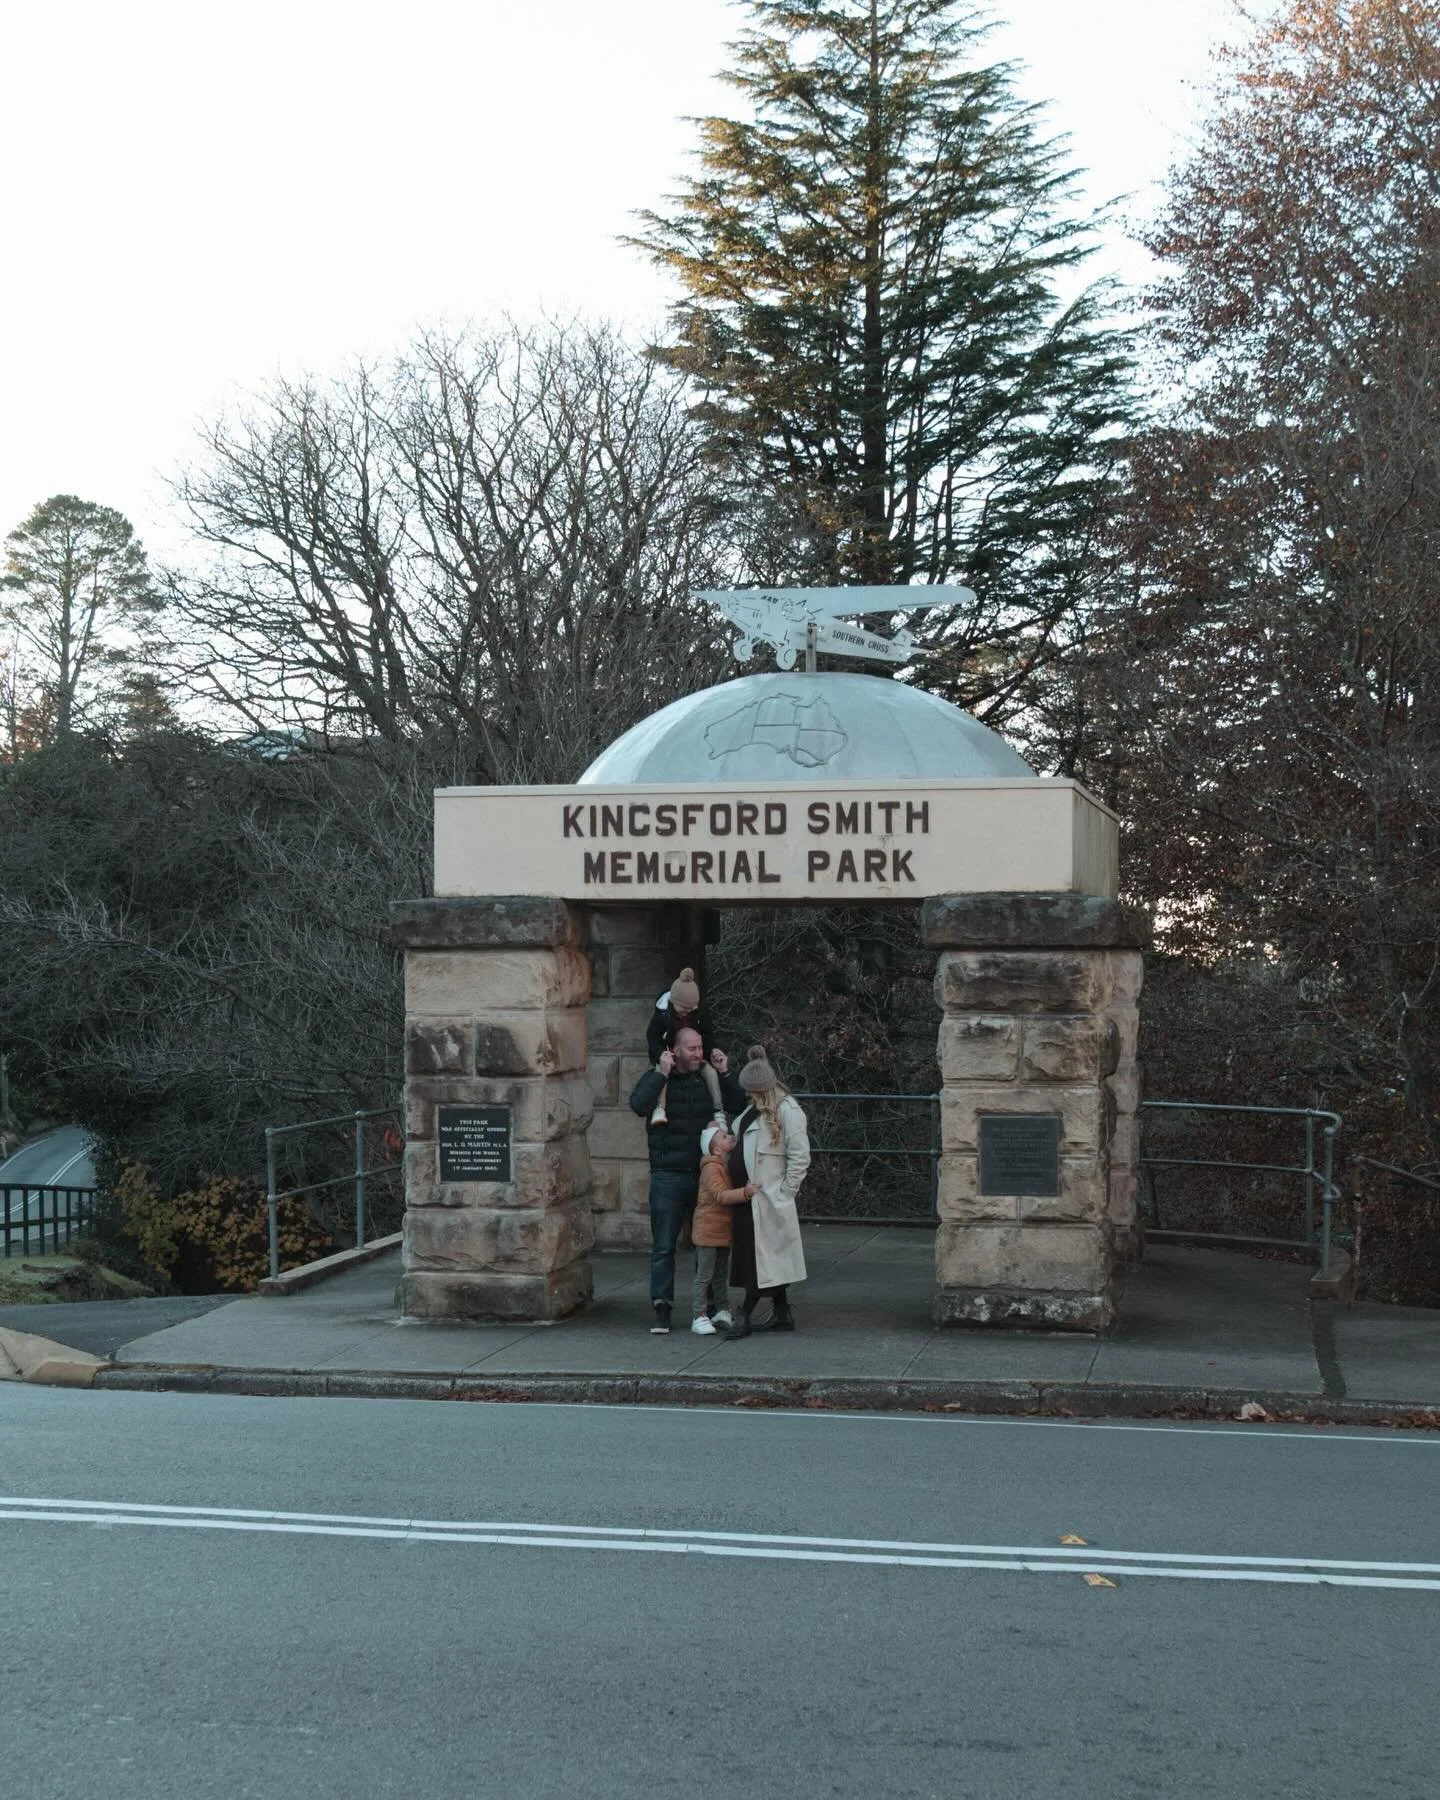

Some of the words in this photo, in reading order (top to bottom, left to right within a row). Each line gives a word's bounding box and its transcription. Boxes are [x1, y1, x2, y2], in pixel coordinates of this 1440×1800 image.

[832, 630, 865, 646] SOUTHERN
[868, 640, 889, 653] CROSS
[807, 801, 930, 836] SMITH
[583, 849, 781, 884] MEMORIAL
[807, 849, 915, 883] PARK
